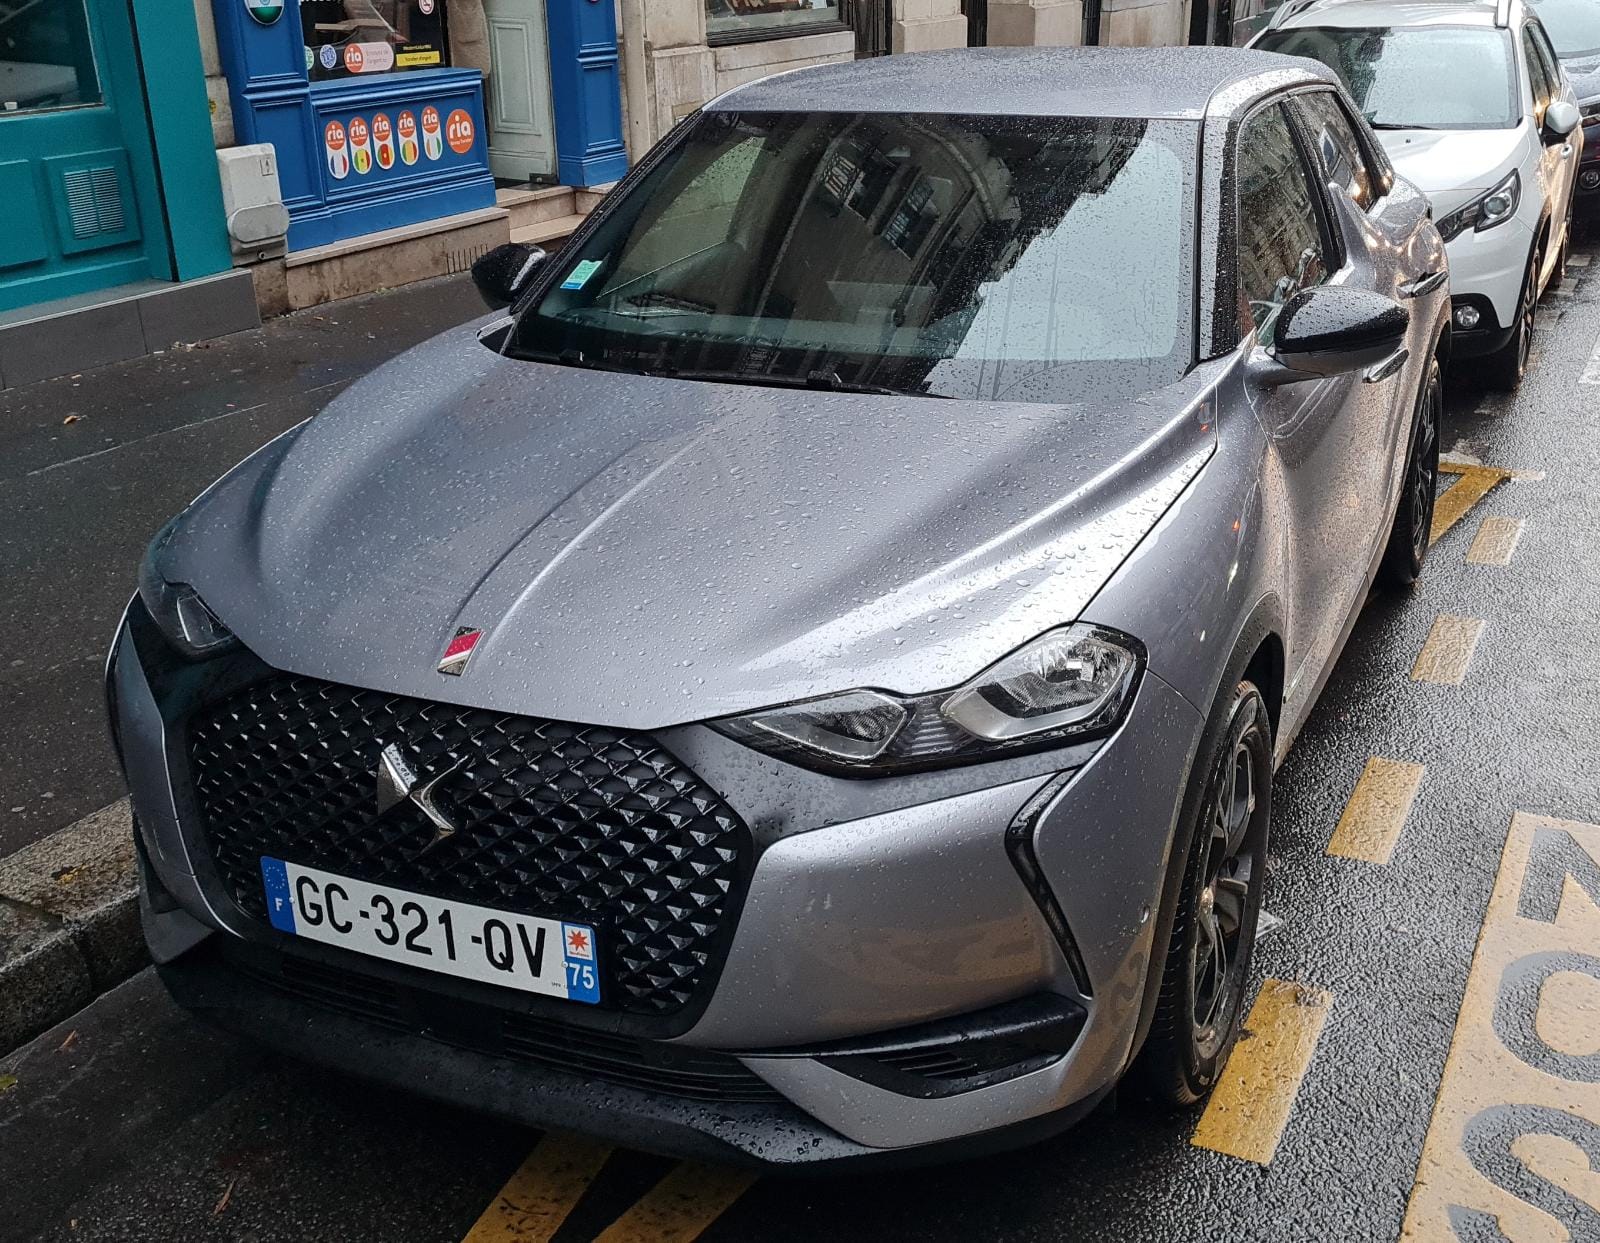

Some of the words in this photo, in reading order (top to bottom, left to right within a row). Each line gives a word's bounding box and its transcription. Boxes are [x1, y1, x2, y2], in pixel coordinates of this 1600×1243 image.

[346, 47, 362, 63] ria
[374, 116, 389, 132] ria
[399, 113, 414, 129] ria
[423, 109, 438, 124] ria
[327, 124, 344, 141] ria
[350, 120, 367, 137] ria
[449, 114, 471, 139] ria
[274, 897, 283, 911] F
[295, 875, 546, 978] GC-321-QV
[569, 962, 595, 989] 75
